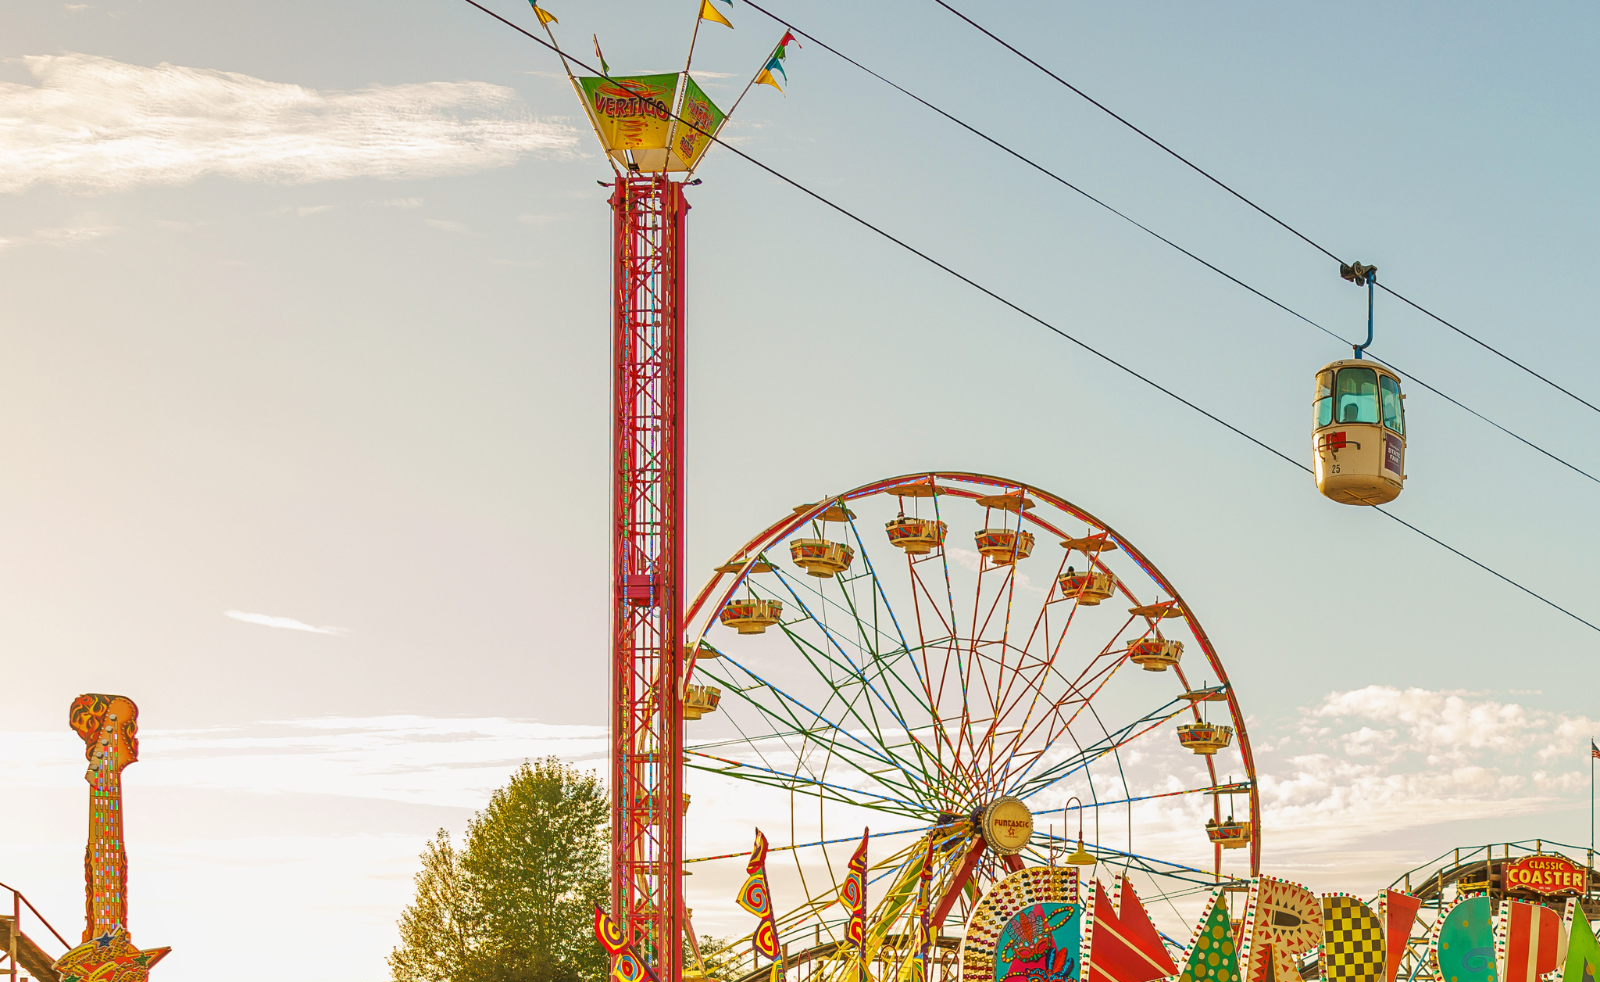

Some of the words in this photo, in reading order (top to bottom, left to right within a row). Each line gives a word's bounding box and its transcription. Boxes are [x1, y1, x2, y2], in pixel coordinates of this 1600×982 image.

[594, 91, 670, 120] VERTIGO
[1332, 465, 1340, 474] 25
[1529, 860, 1564, 871] CLASSIC
[1508, 868, 1583, 887] COASTER
